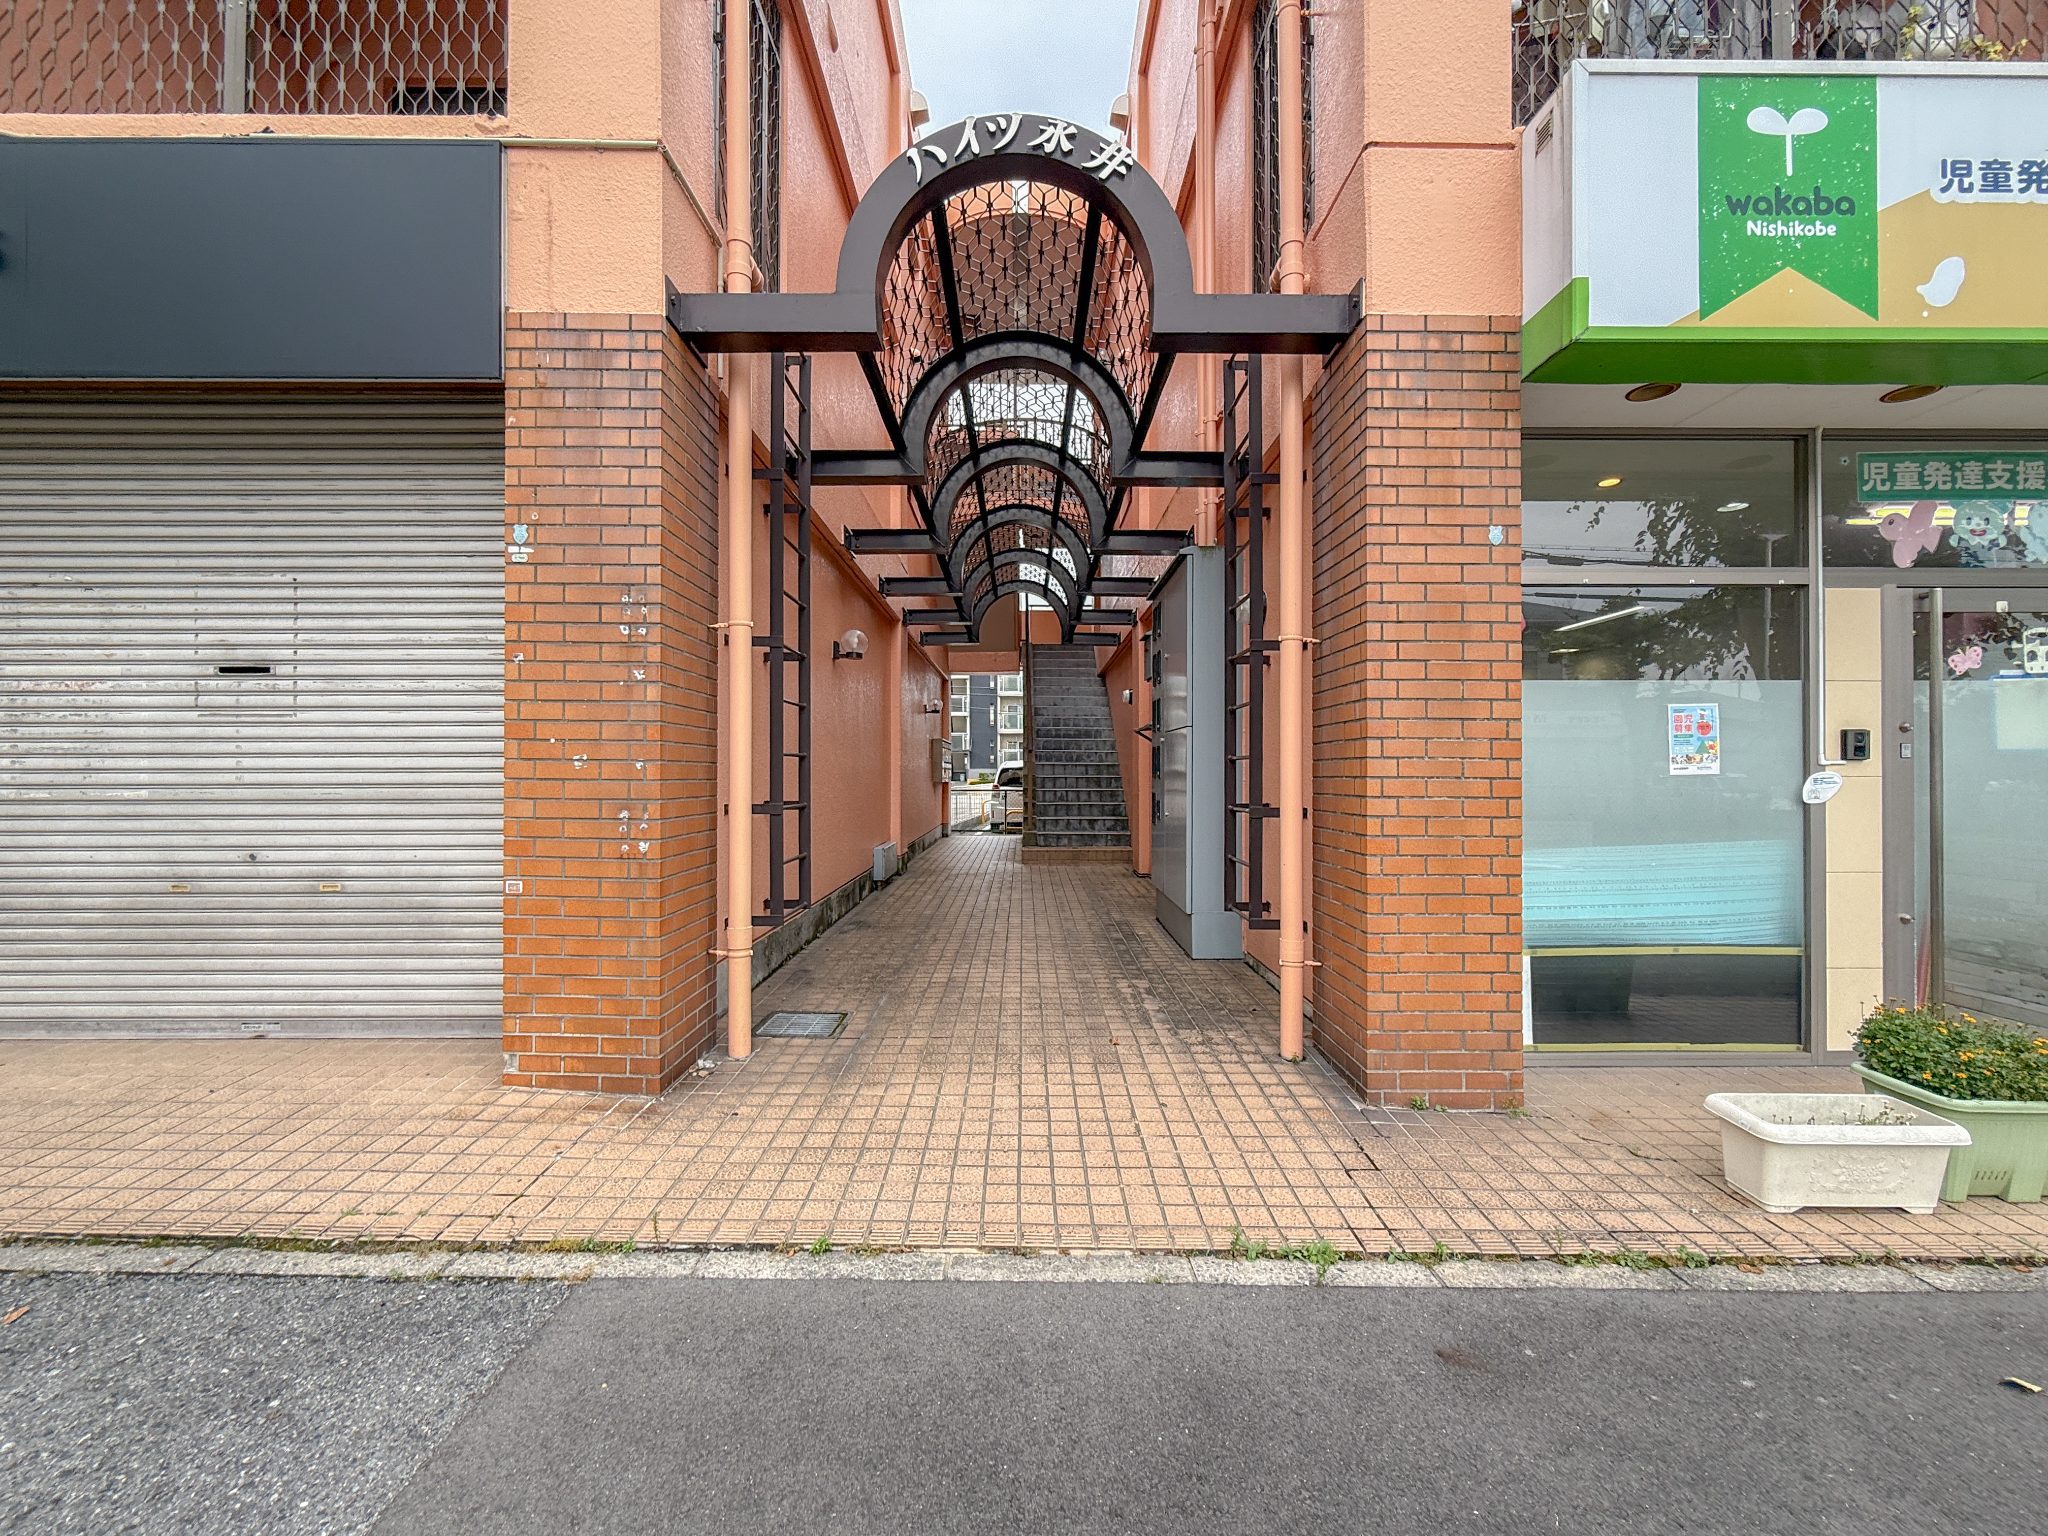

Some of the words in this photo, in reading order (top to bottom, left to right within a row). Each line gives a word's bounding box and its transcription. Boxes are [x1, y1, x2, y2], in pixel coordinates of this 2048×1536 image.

[907, 113, 1134, 184] ハイツ永井
[1940, 158, 2048, 194] 児童発
[1725, 186, 1856, 216] wakaba
[1746, 220, 1837, 236] Nishikobe
[1862, 461, 2046, 492] 児童発達支援
